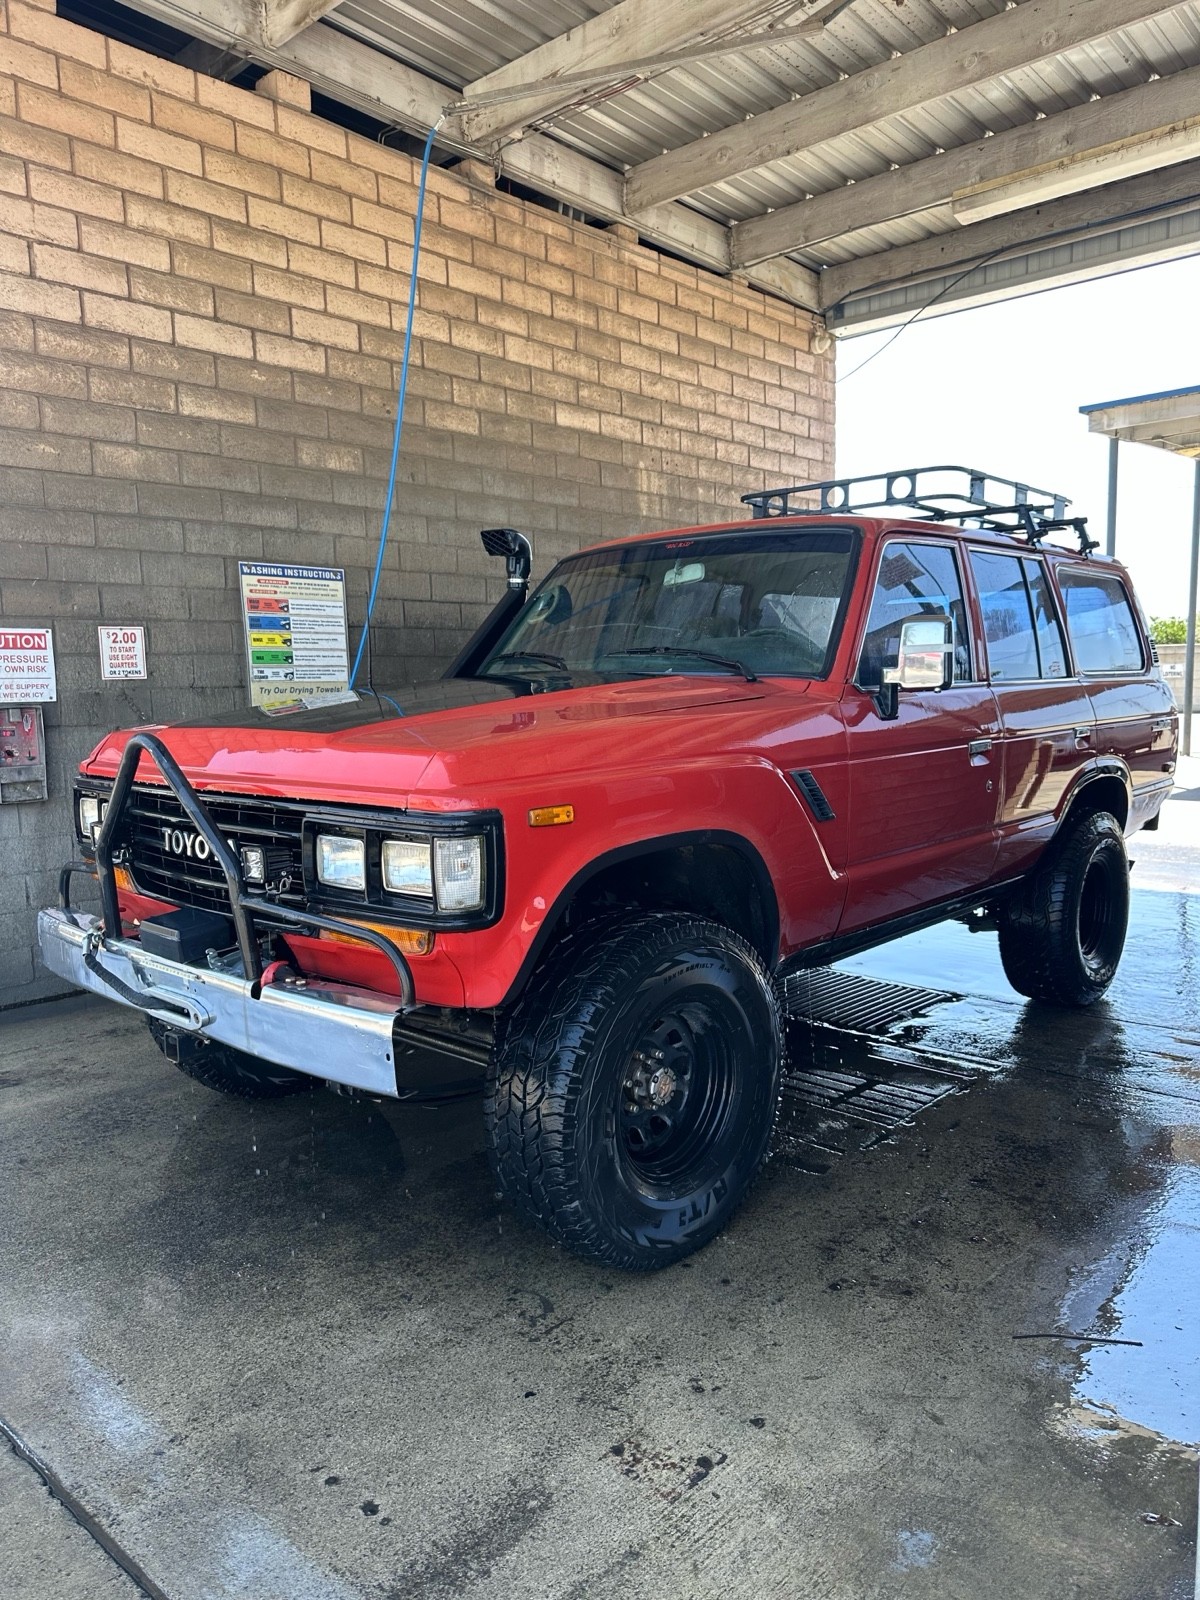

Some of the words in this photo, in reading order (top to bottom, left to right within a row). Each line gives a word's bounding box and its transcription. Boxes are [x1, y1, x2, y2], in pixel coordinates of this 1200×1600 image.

[242, 565, 283, 576] WASHING
[284, 569, 341, 580] INSTRUCTIONS
[106, 631, 137, 644] $2.00
[4, 665, 25, 673] OWN
[27, 665, 47, 673] RISK
[259, 687, 272, 696] Try
[273, 686, 288, 694] Our
[289, 686, 314, 695] Drying
[316, 685, 343, 693] Towels!
[161, 826, 239, 863] TOYO
